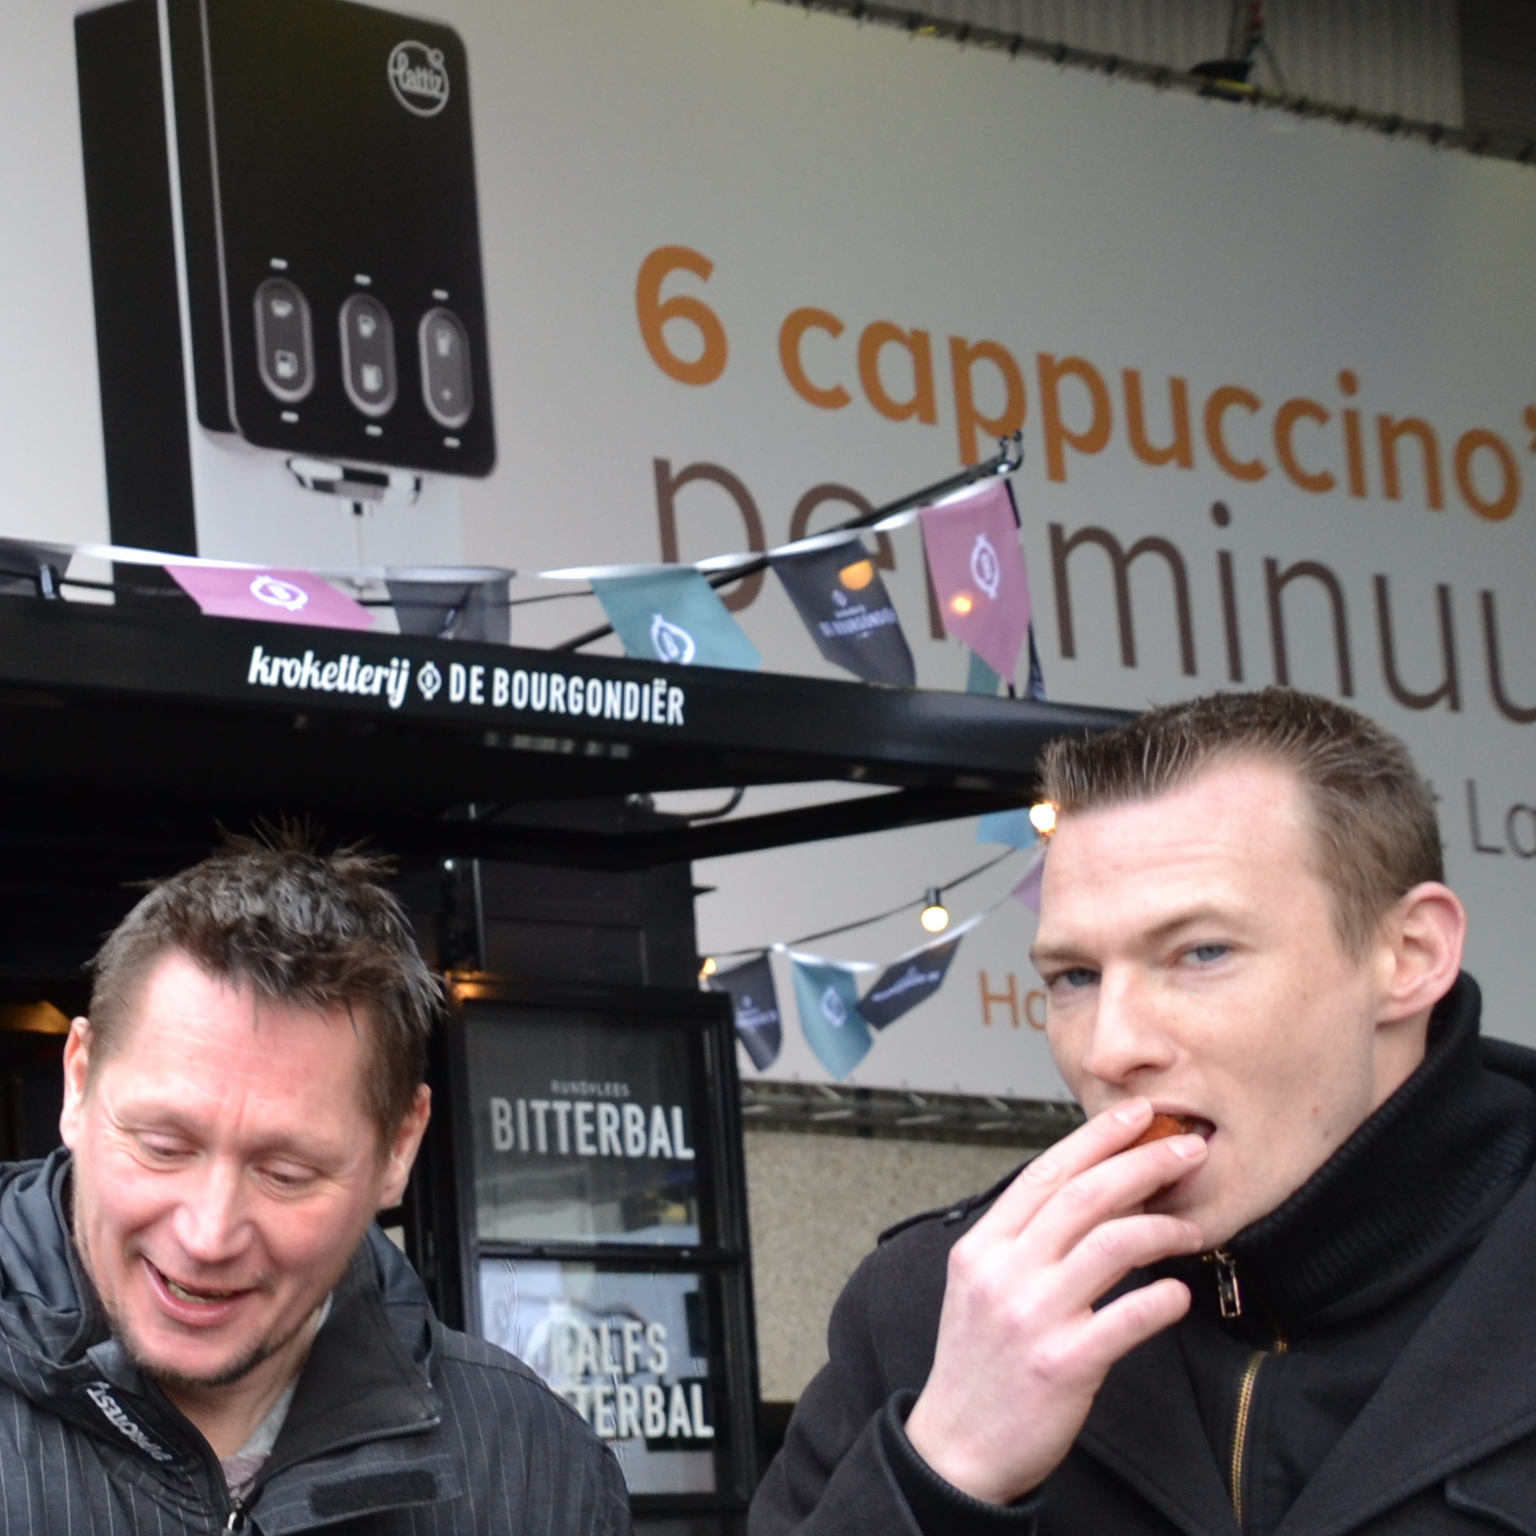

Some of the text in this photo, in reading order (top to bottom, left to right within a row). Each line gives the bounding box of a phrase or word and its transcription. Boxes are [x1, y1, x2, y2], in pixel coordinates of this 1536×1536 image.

[634, 244, 729, 387] 6
[247, 645, 685, 727] kroketterij DE BOURGONDIËR
[490, 1097, 696, 1160] BITTERBAL
